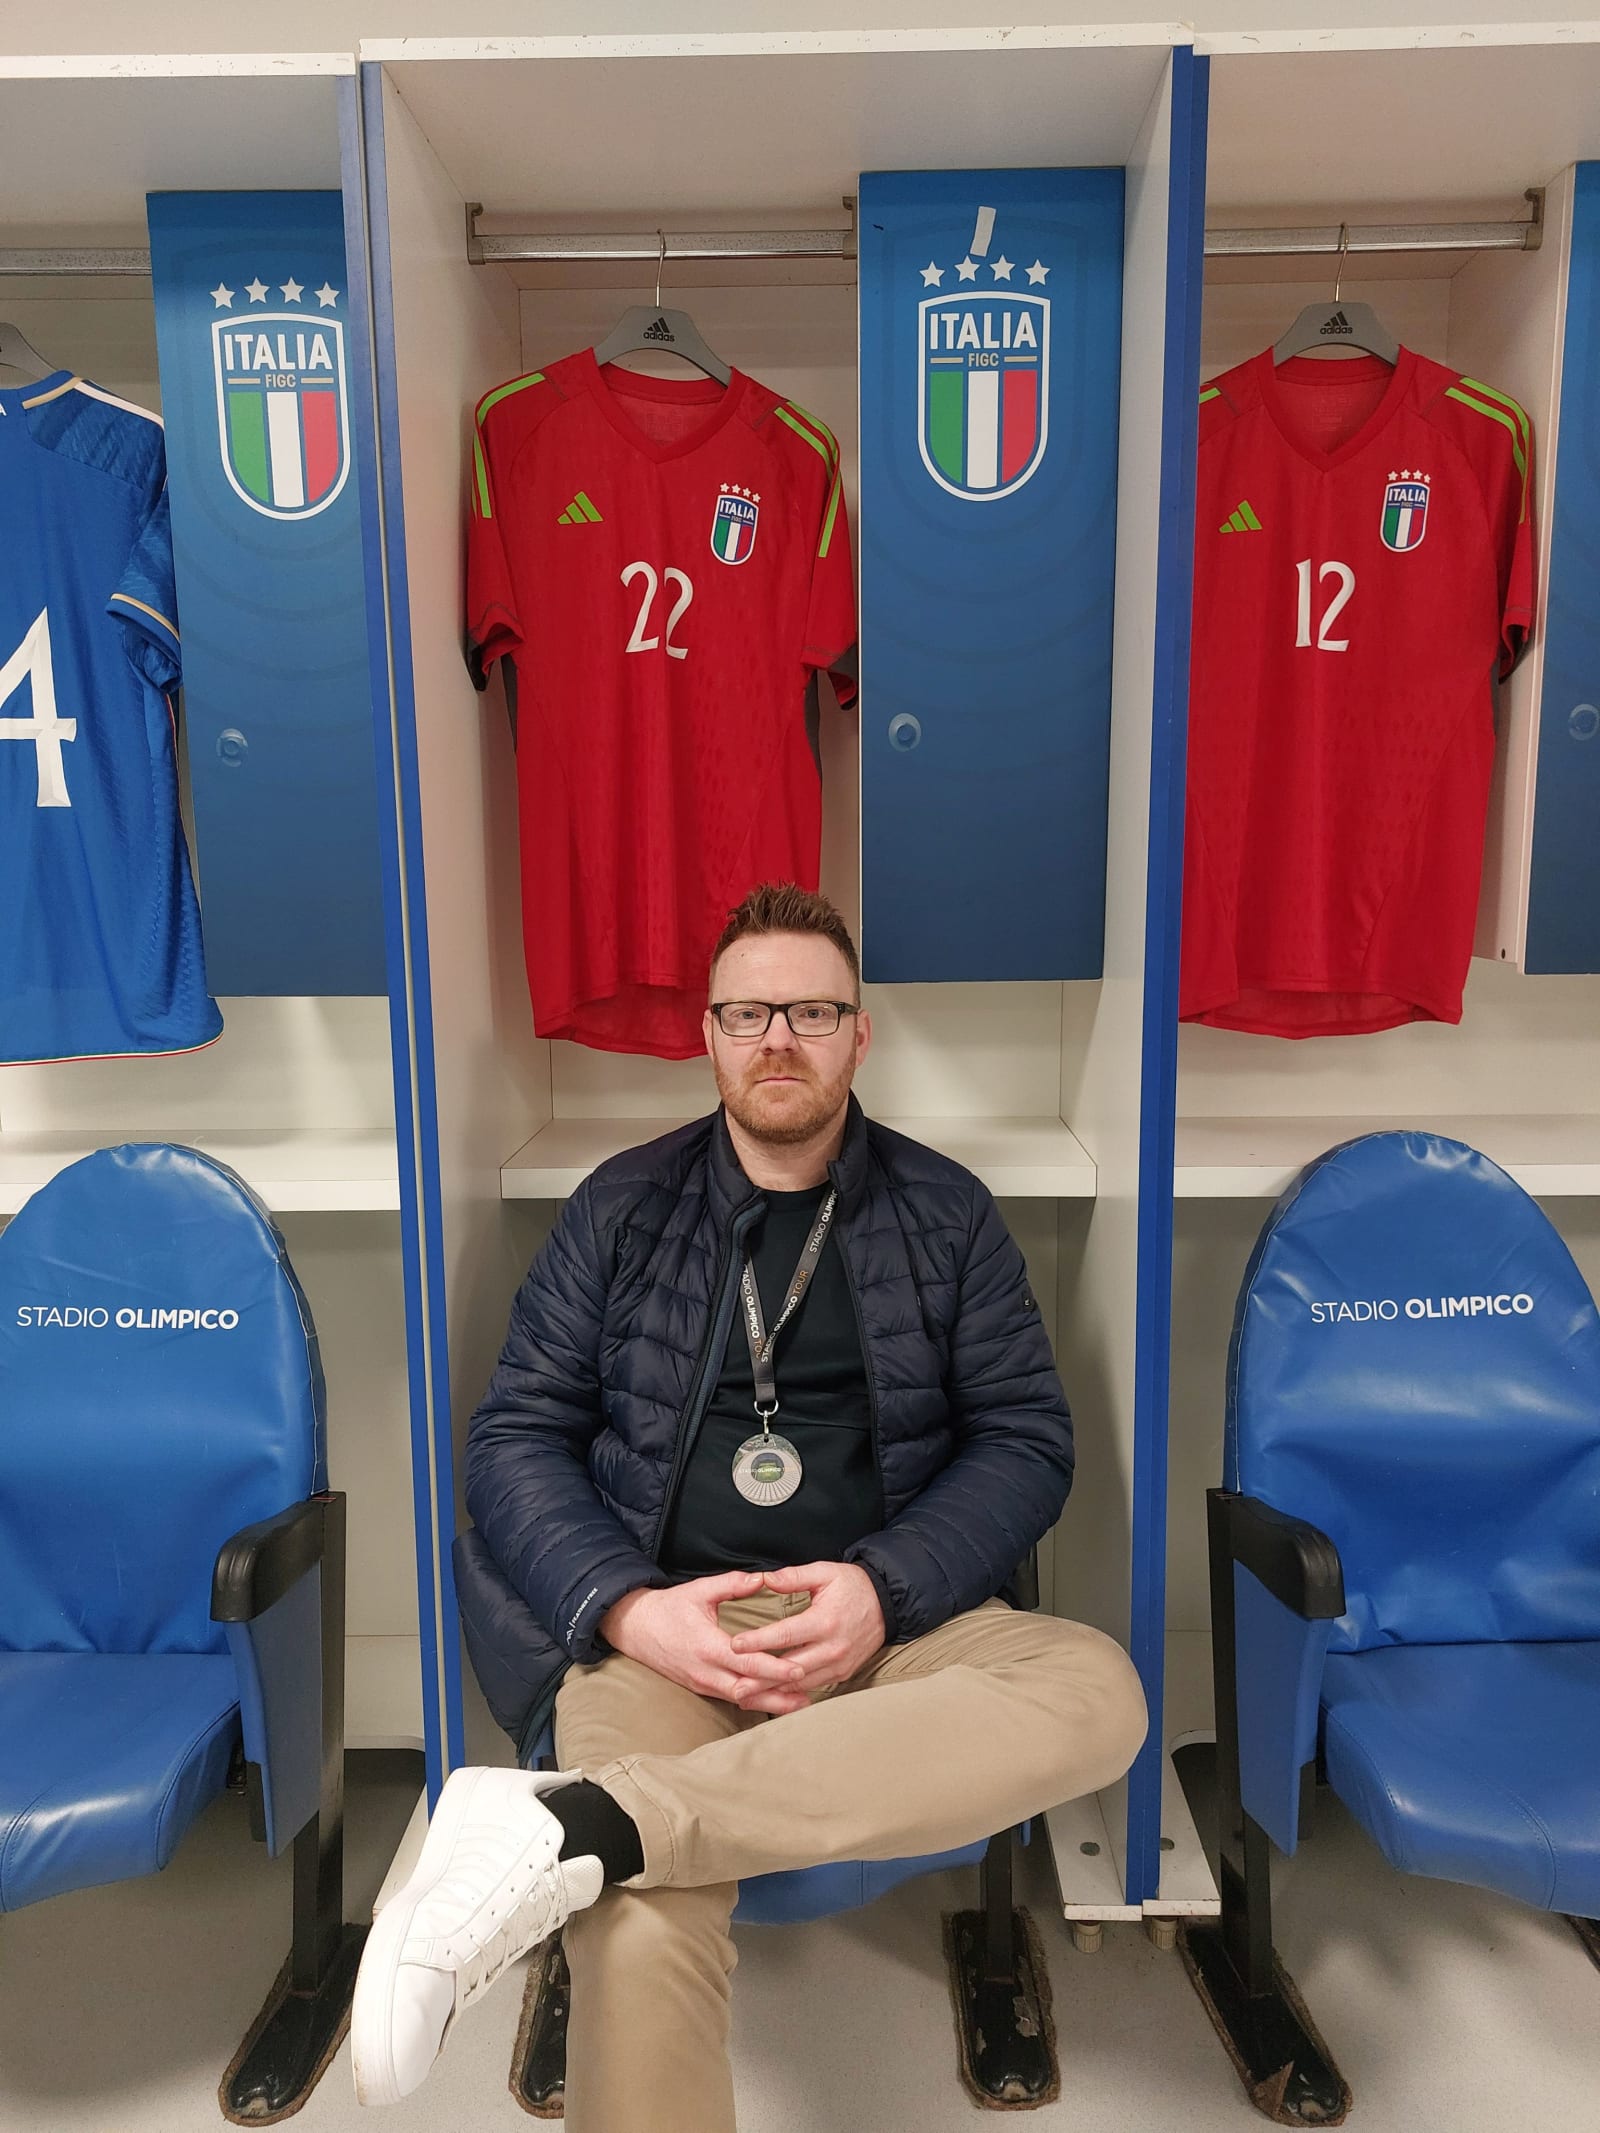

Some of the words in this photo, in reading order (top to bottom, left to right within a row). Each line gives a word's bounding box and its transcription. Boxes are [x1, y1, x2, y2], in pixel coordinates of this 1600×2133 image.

[643, 331, 675, 342] adidas
[930, 312, 1038, 350] ITALIA
[1319, 325, 1353, 335] adidas
[224, 333, 333, 370] ITALIA
[968, 352, 999, 367] FIGC
[265, 373, 296, 388] FIGC
[719, 499, 754, 521] ITALIA
[1388, 488, 1426, 503] ITALIA
[620, 561, 694, 660] 22
[1295, 558, 1356, 652] 12
[0, 605, 77, 808] 4
[809, 1222, 828, 1254] STADIO
[773, 1295, 798, 1332] OLIMPICO
[792, 1269, 809, 1295] TOUR
[1311, 1299, 1398, 1323] STADIO
[1404, 1293, 1534, 1319] OLIMPICO
[16, 1306, 109, 1328] STADIO
[115, 1307, 239, 1330] OLIMPICO
[746, 1296, 760, 1339] OLIMPICO
[571, 1599, 589, 1624] FEATHER
[587, 1587, 599, 1601] FREE
